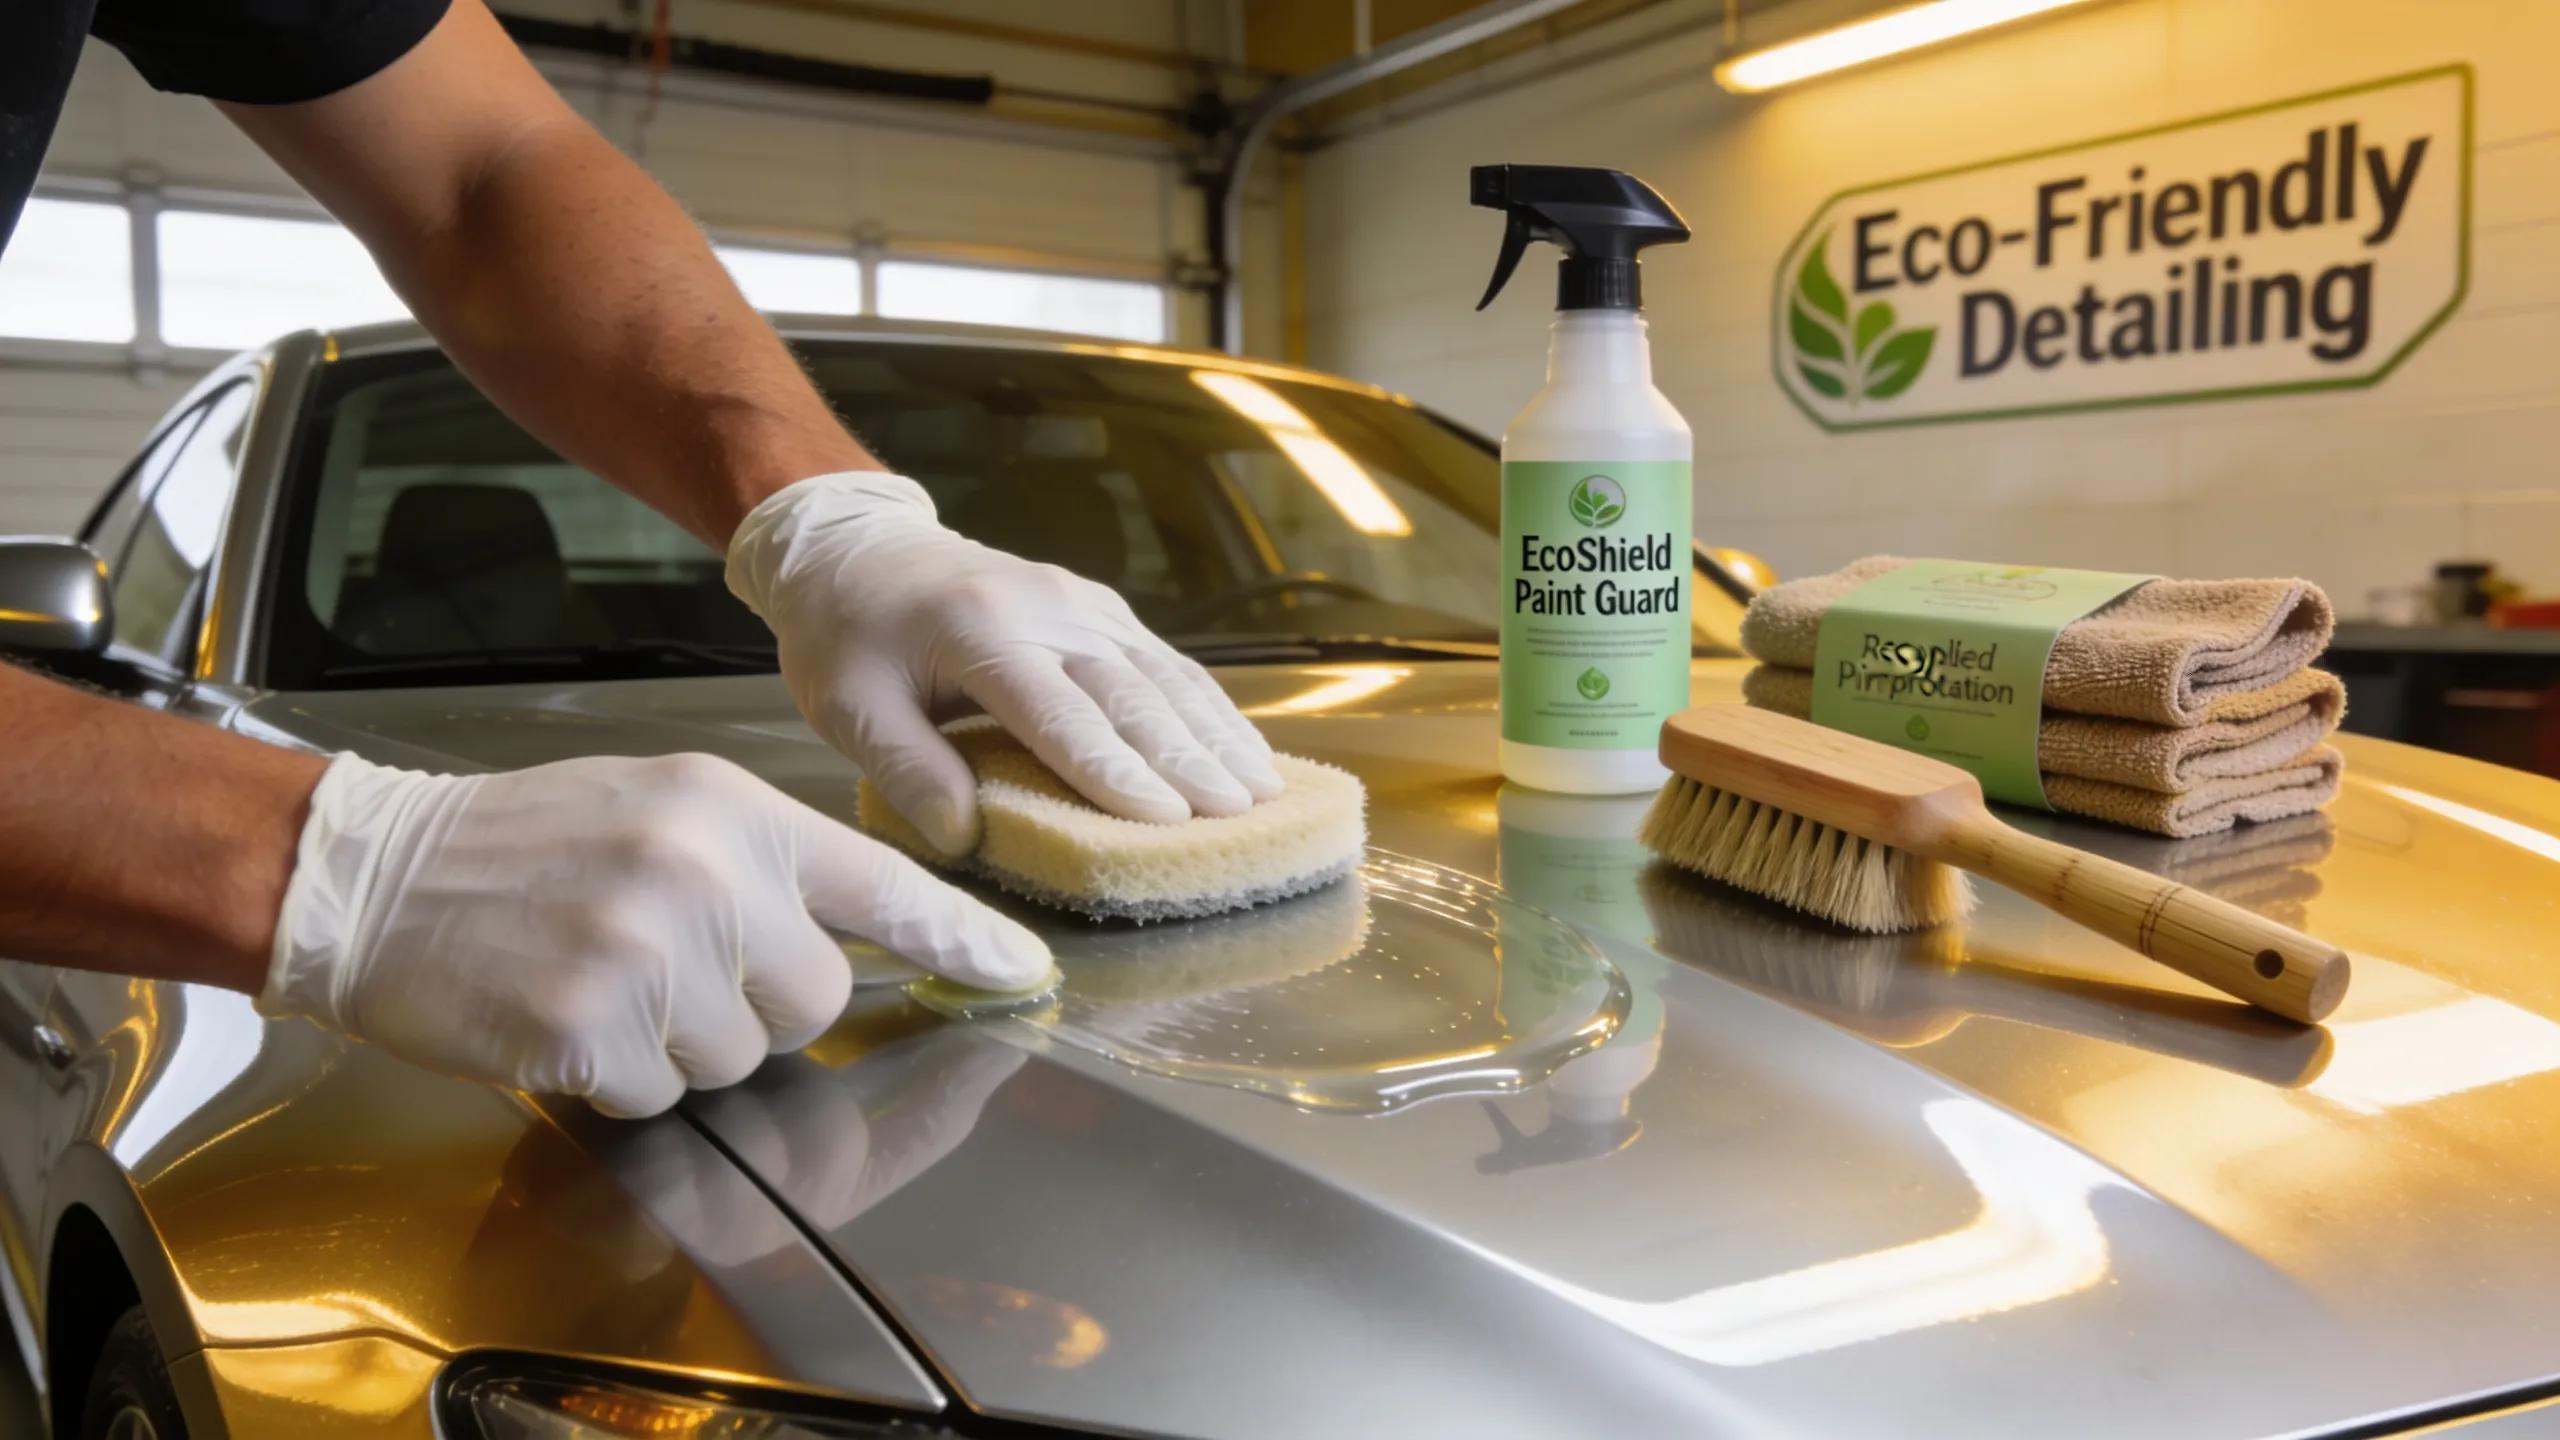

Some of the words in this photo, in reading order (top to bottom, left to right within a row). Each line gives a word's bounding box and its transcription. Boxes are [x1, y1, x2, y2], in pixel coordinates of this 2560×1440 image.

[1852, 123, 2431, 294] Eco-Friendly
[1958, 256, 2376, 379] Detailing
[1521, 532, 1671, 572] EcoShield
[1514, 578, 1586, 615] Paint
[1595, 576, 1679, 615] Guard
